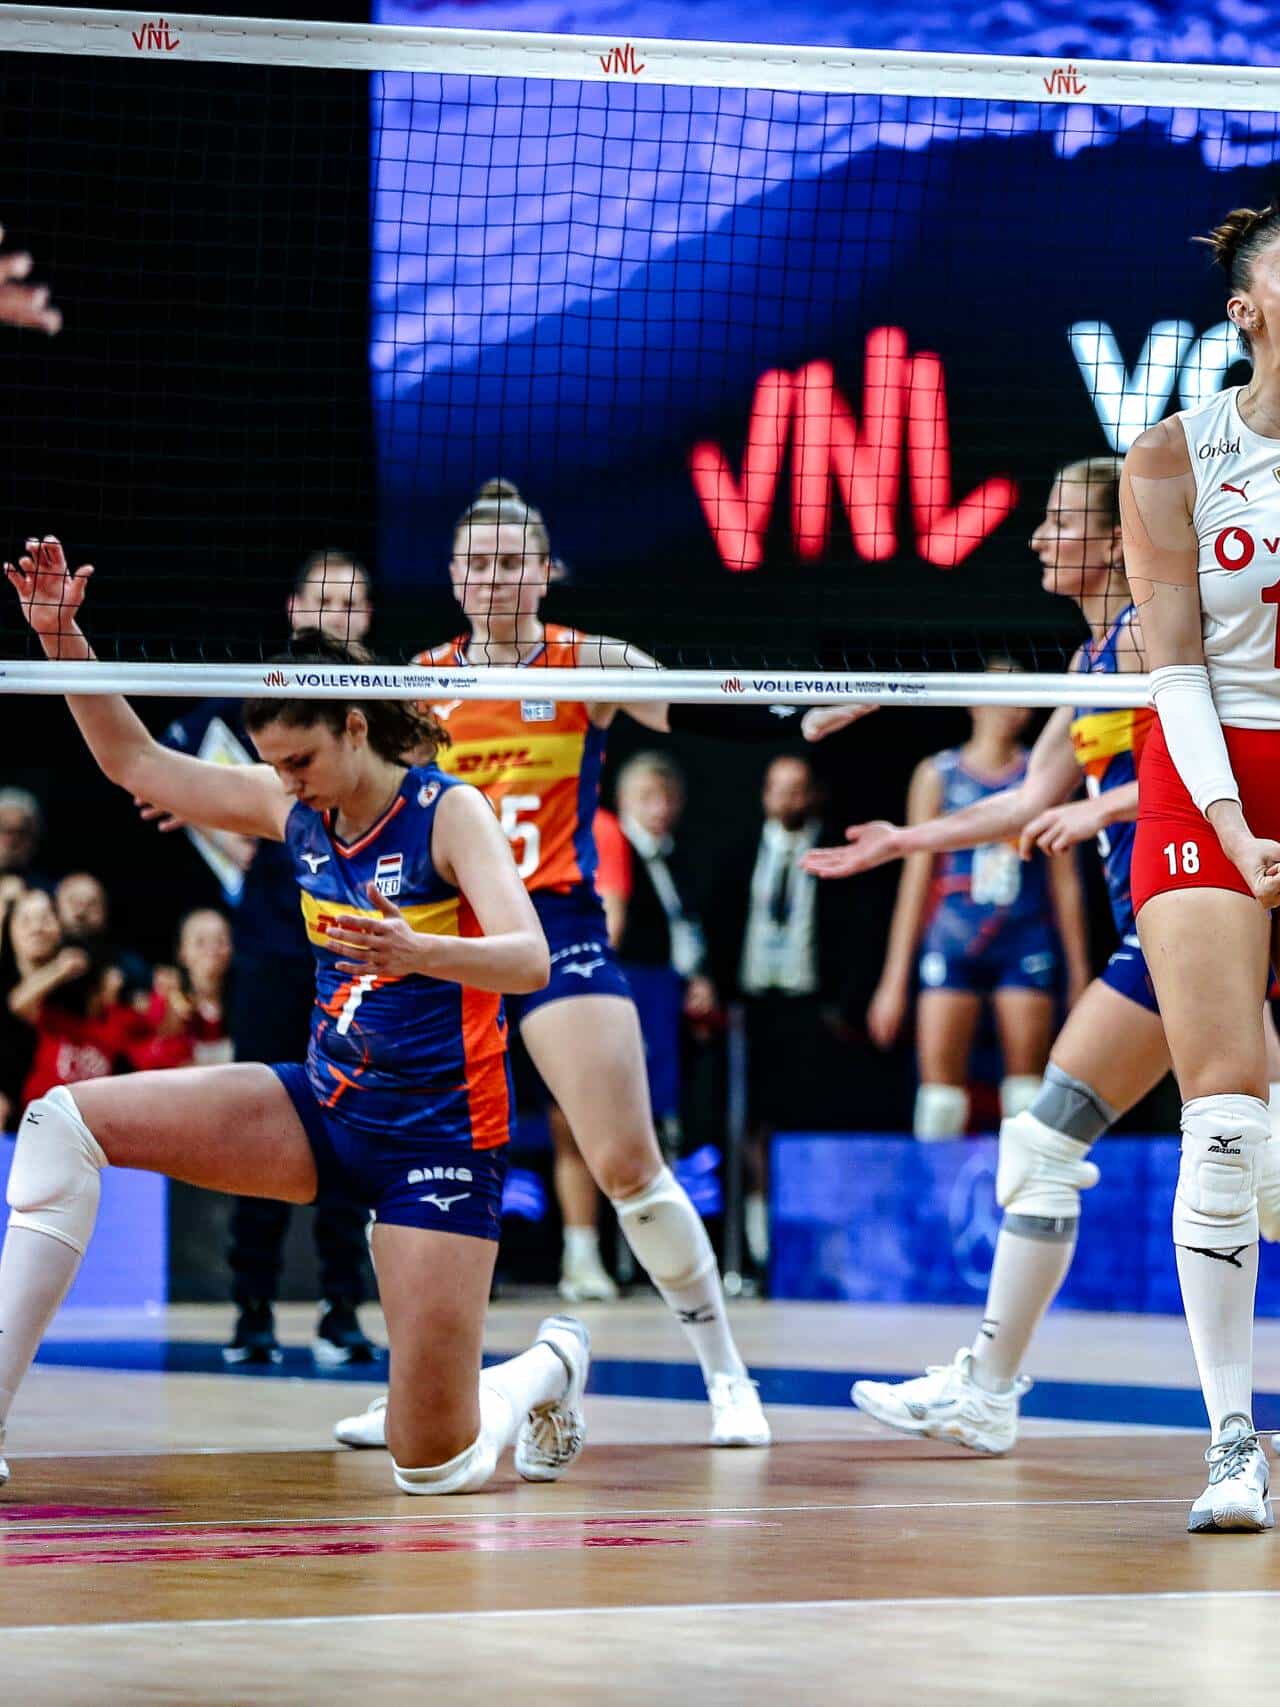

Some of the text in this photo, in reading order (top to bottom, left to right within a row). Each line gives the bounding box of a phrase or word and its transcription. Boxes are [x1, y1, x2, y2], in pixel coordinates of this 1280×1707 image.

[132, 17, 180, 51] VNL
[600, 42, 645, 75] VNL
[1043, 63, 1087, 96] VNL
[692, 325, 1018, 572] VNL
[1199, 437, 1241, 460] Orkid
[263, 670, 401, 688] VNL VOLLEYBALL
[721, 677, 852, 693] VNL VOLLEYBALL
[1163, 841, 1200, 876] 18
